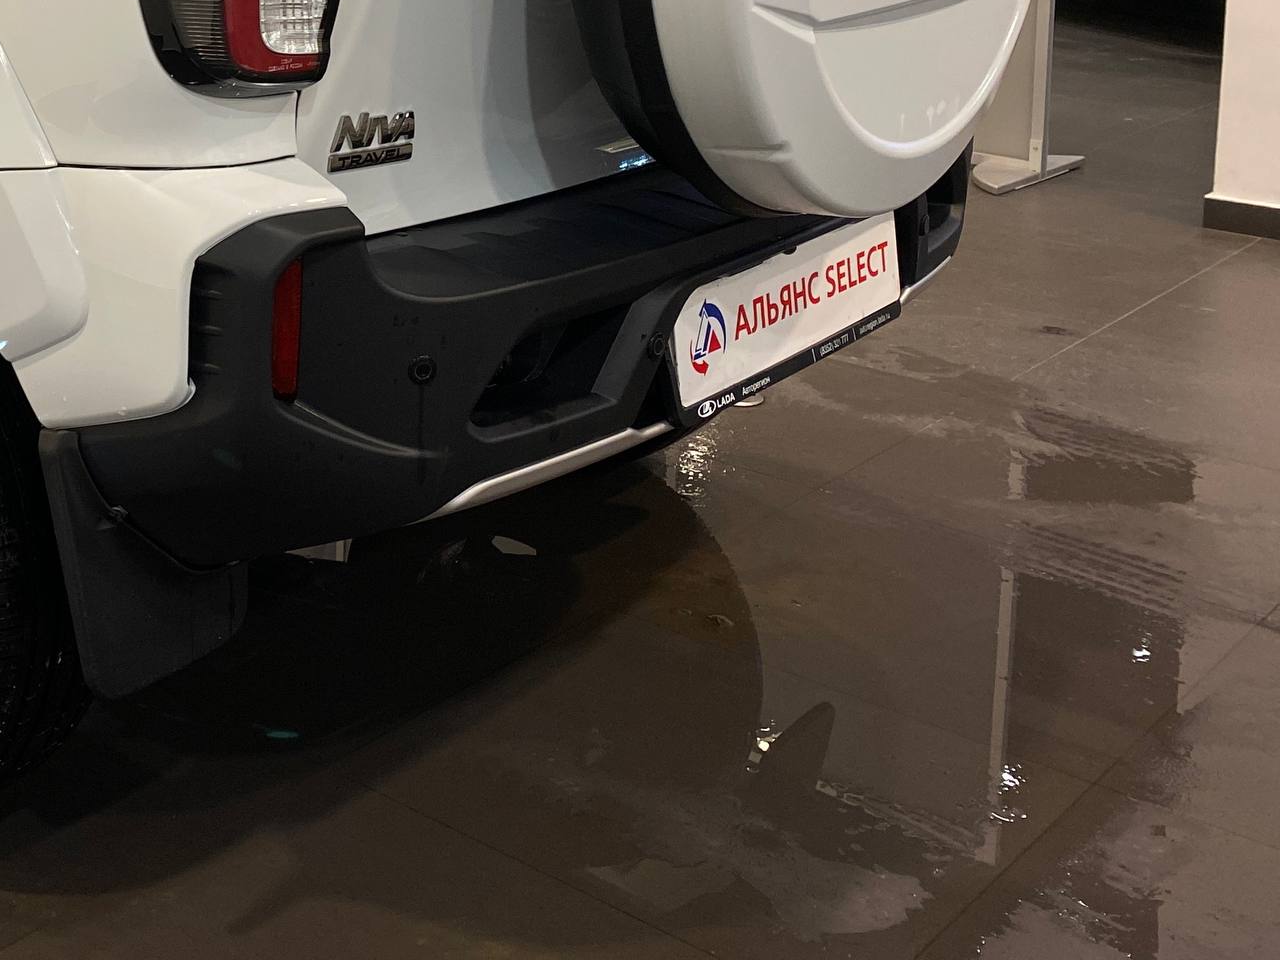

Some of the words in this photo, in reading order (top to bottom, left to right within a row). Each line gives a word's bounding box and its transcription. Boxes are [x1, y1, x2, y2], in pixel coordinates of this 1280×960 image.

[329, 110, 415, 154] NIVA
[337, 147, 407, 169] TRAVEL
[734, 271, 821, 341] АЛЬЯНС
[825, 241, 888, 298] SELECT
[716, 392, 736, 408] LADA
